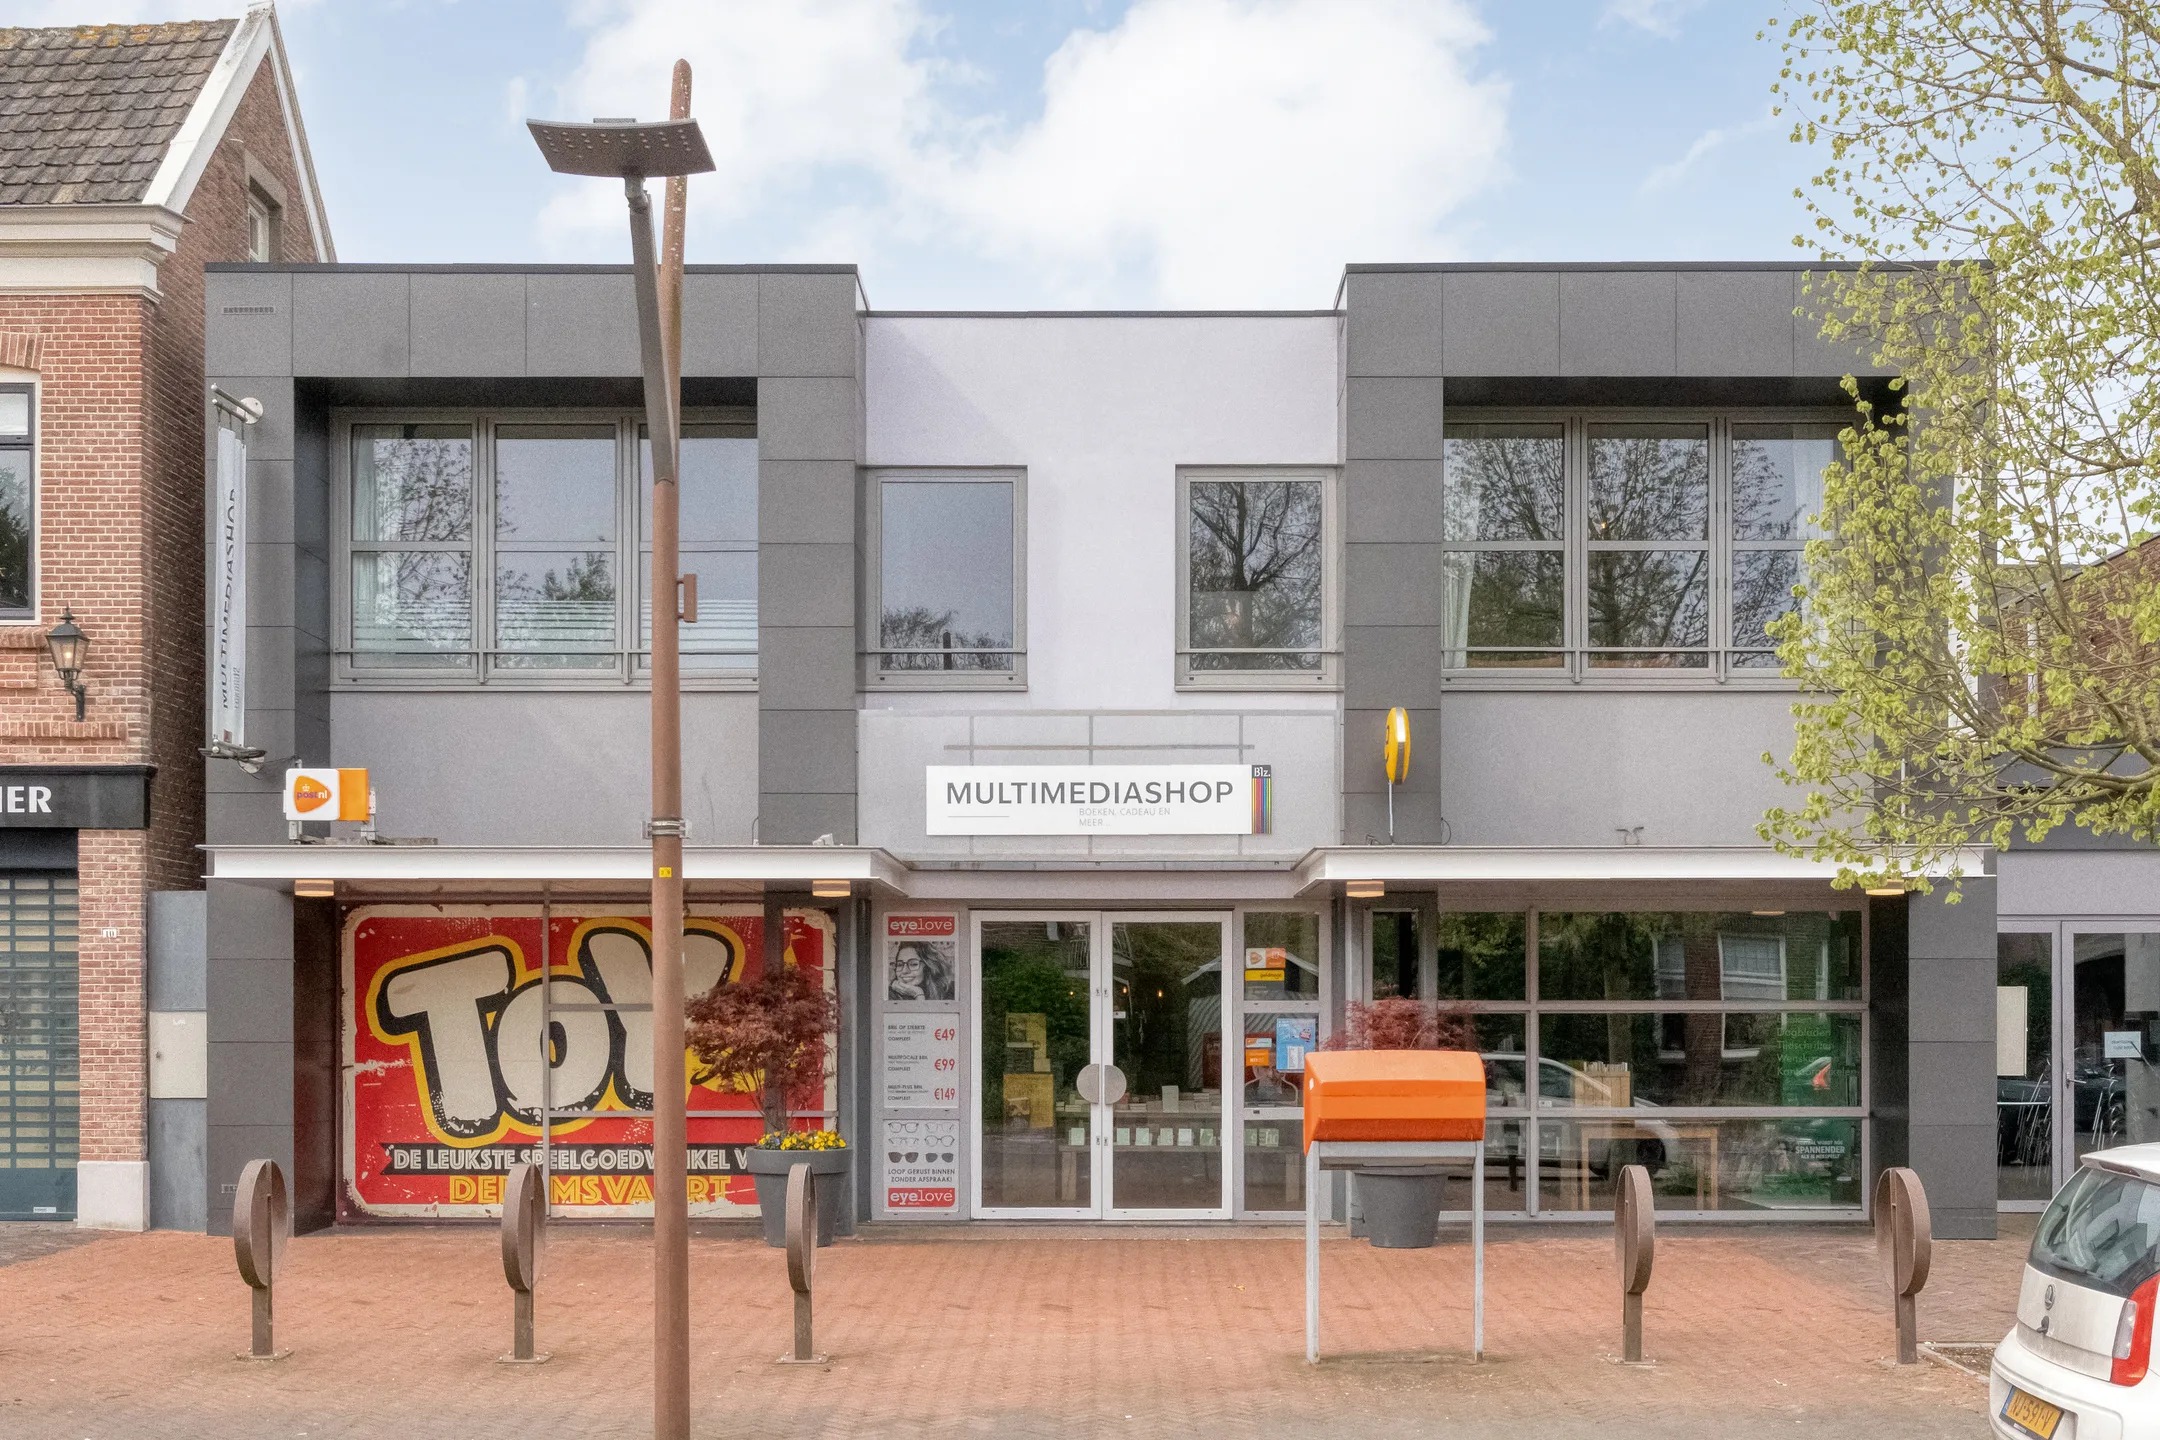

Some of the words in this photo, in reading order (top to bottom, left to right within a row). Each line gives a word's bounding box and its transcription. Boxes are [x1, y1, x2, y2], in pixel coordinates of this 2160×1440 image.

[0, 785, 52, 813] ER
[296, 789, 328, 800] postnl
[947, 781, 1234, 804] MULTIMEDIASHOP
[1120, 807, 1156, 816] CADEAU
[1159, 807, 1171, 815] EN
[934, 1028, 956, 1041] €49
[934, 1058, 956, 1071] €99
[934, 1087, 956, 1101] €149
[394, 1149, 421, 1170] DE
[427, 1149, 515, 1171] LEUKSTE
[520, 1149, 730, 1170] SPEELGOEDKEL
[450, 1175, 732, 1204] DEMSVART
